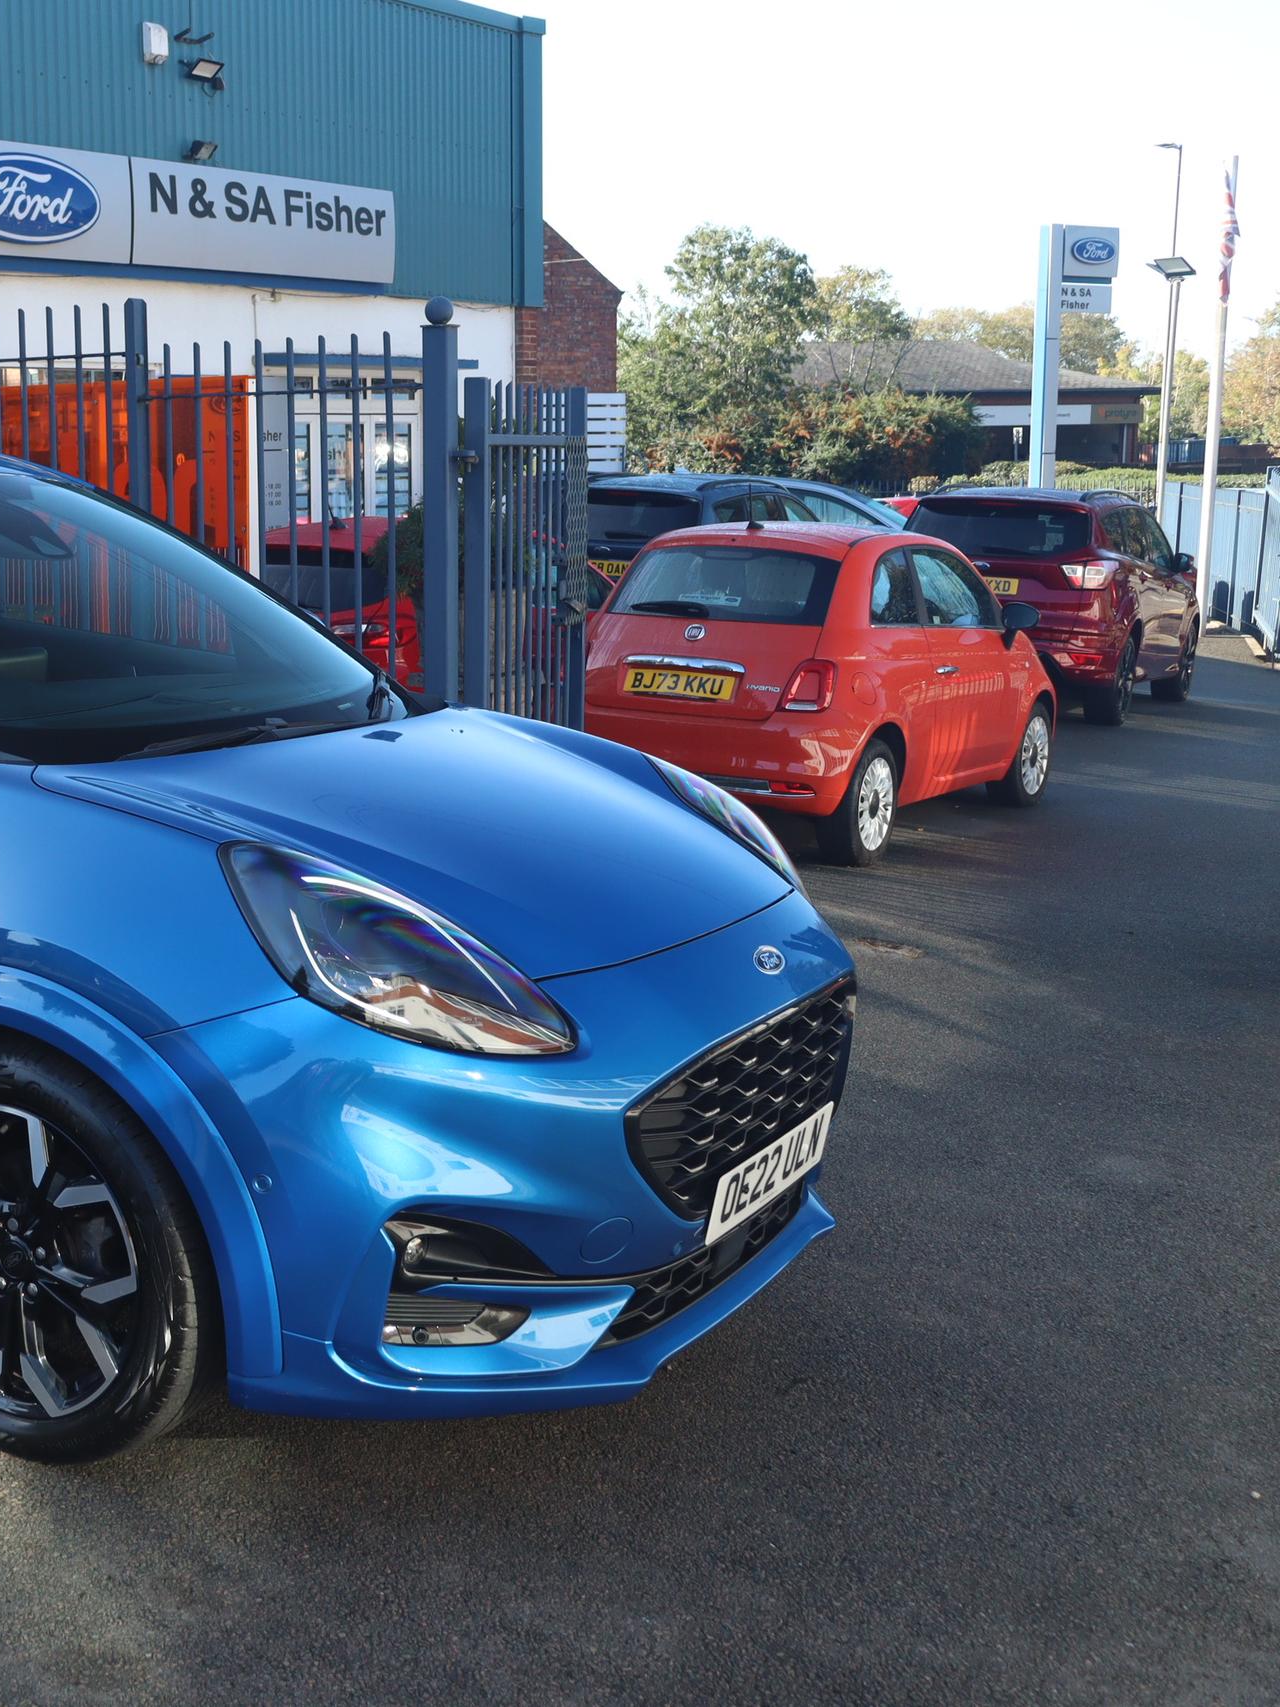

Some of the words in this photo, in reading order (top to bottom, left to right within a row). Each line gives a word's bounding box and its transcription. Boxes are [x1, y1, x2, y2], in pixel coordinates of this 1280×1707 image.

[148, 172, 178, 215] N
[188, 178, 217, 219] &
[224, 181, 277, 225] SA
[283, 189, 387, 237] Fisher
[1083, 241, 1109, 259] Ford
[1061, 287, 1069, 297] N
[1070, 287, 1077, 297] &
[1079, 288, 1092, 297] SA
[1060, 300, 1090, 310] Fisher
[631, 671, 681, 690] BJ73
[683, 675, 724, 696] KKU
[782, 1113, 825, 1180] ULN
